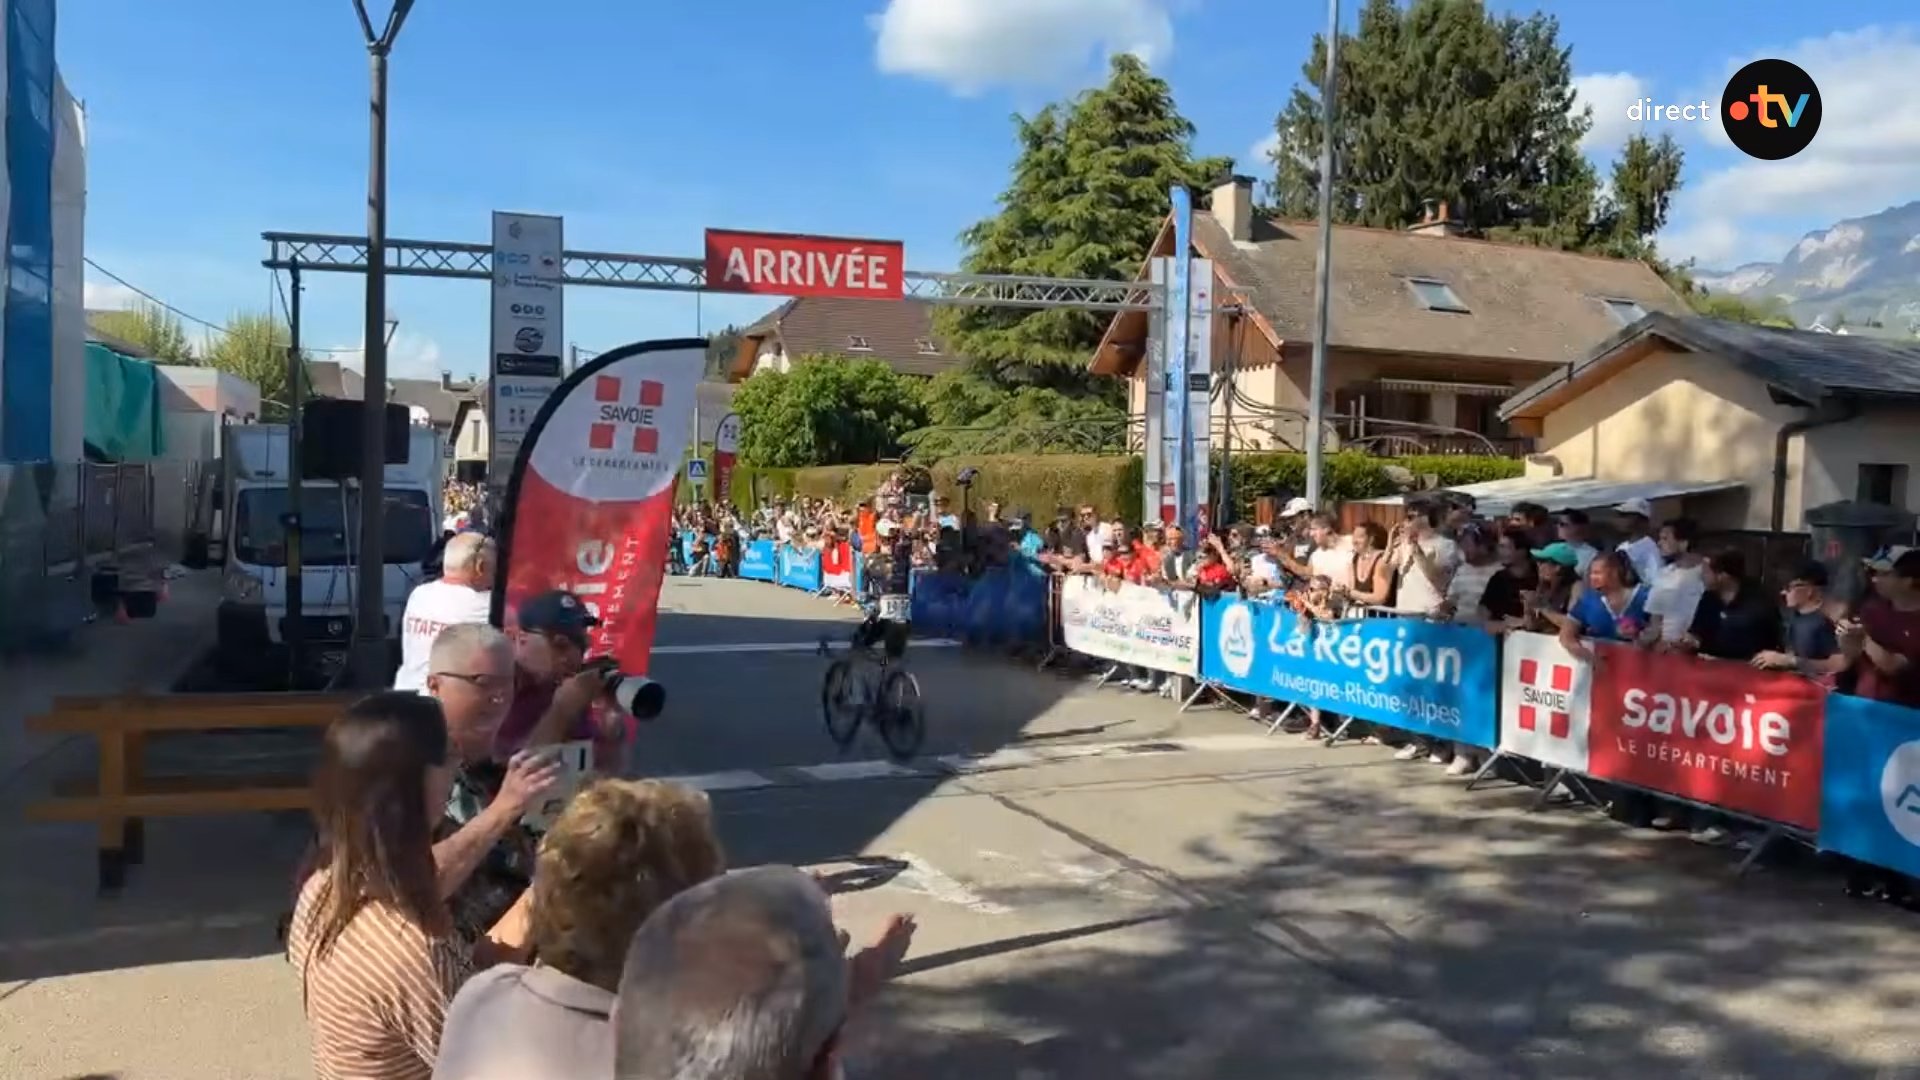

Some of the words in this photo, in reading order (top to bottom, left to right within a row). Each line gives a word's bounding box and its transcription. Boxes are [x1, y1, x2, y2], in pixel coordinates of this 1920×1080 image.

[723, 246, 888, 290] ARRIVÉE
[599, 404, 654, 426] SAVOIE
[1268, 609, 1308, 658] La
[1314, 620, 1462, 686] Région
[1271, 666, 1461, 726] Auvergne-Rhône-Alpes
[1522, 685, 1566, 710] SAVOIE
[1621, 687, 1792, 757] savoie
[1617, 736, 1638, 755] LE
[1646, 740, 1792, 789] DÉPARTEMENT
